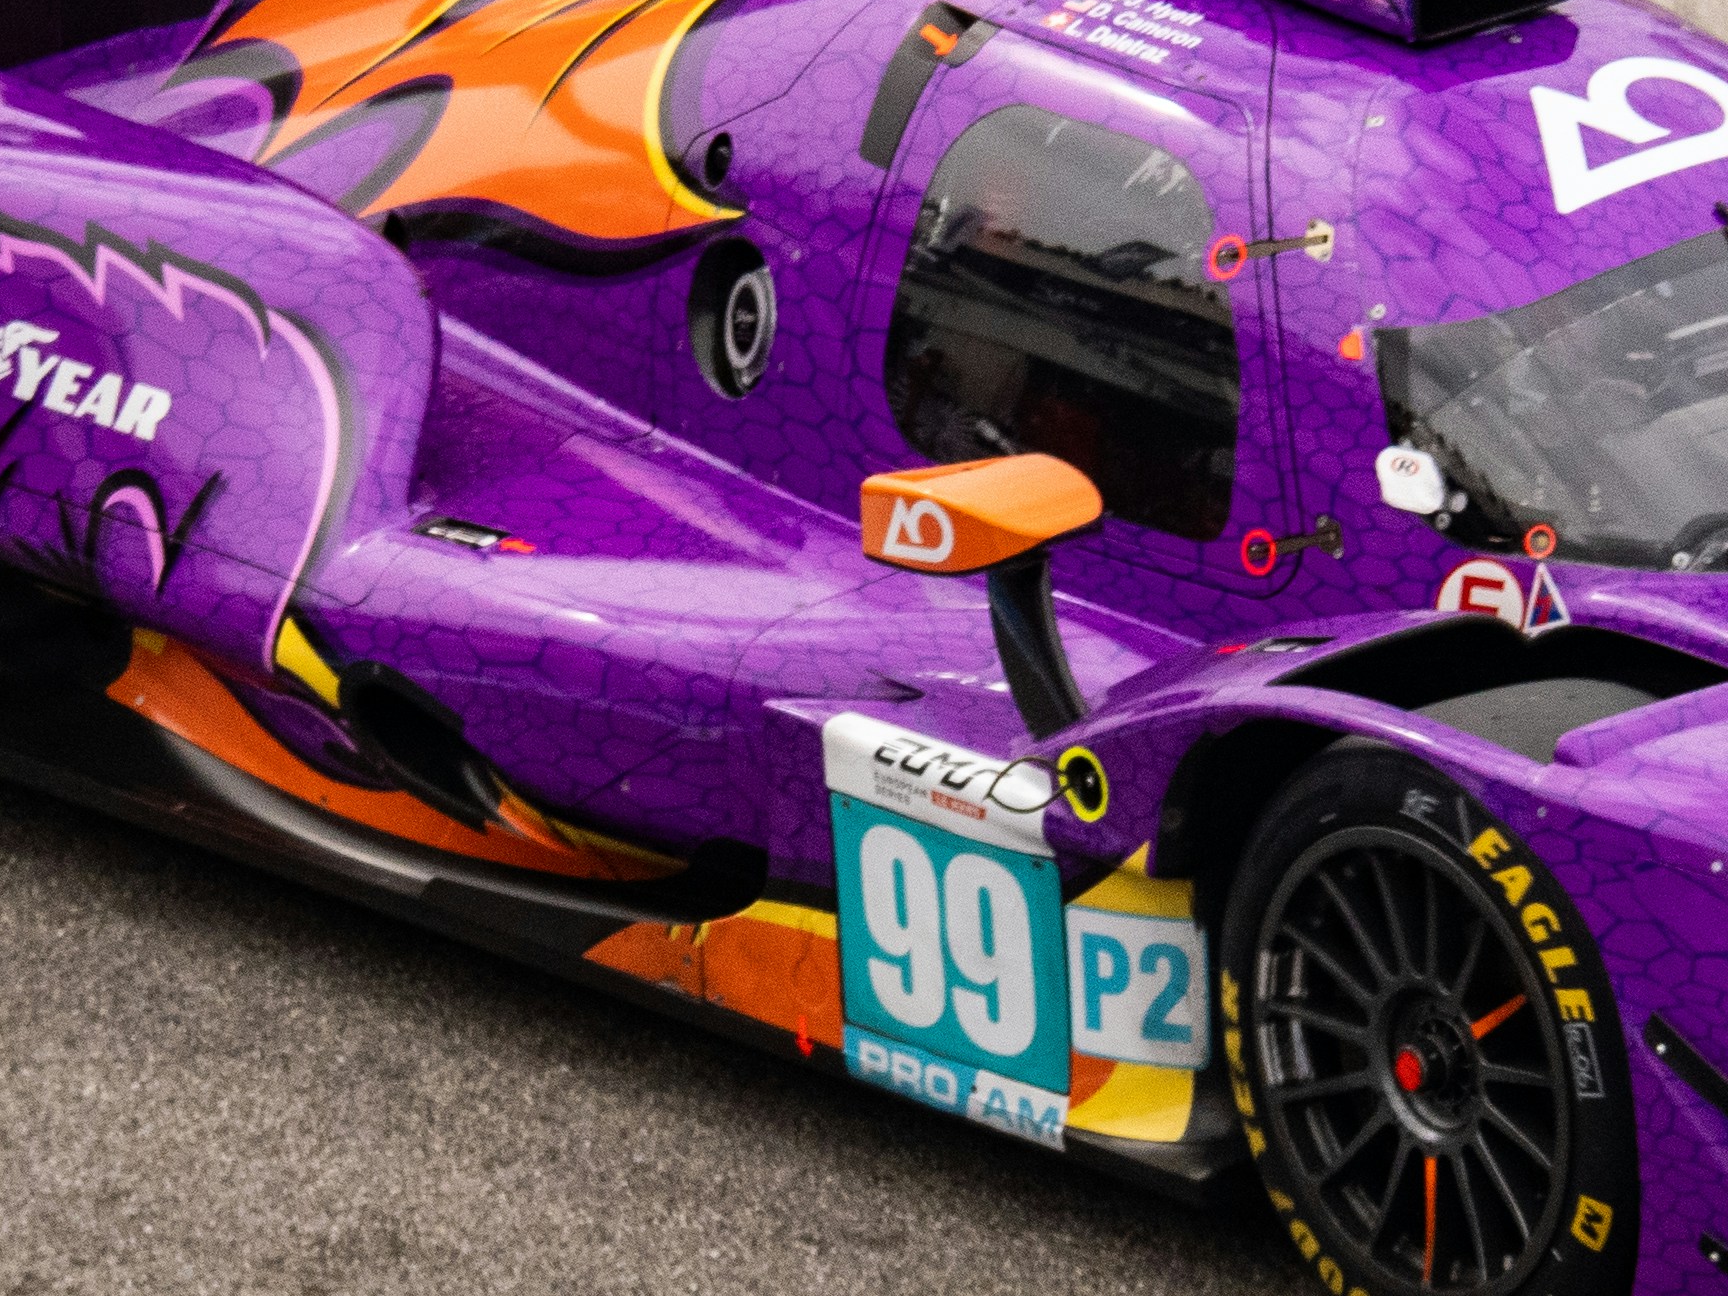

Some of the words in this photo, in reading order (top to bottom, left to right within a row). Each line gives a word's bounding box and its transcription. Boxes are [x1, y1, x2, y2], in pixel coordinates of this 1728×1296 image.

[1063, 17, 1084, 39] L.
[1086, 2, 1114, 21] D.
[1112, 10, 1204, 50] Cameron
[859, 823, 1038, 1058] 99
[1467, 826, 1596, 1024] EAGLE
[1080, 931, 1194, 1045] P2
[856, 1038, 960, 1105] PRO
[985, 1086, 1060, 1142] AM
